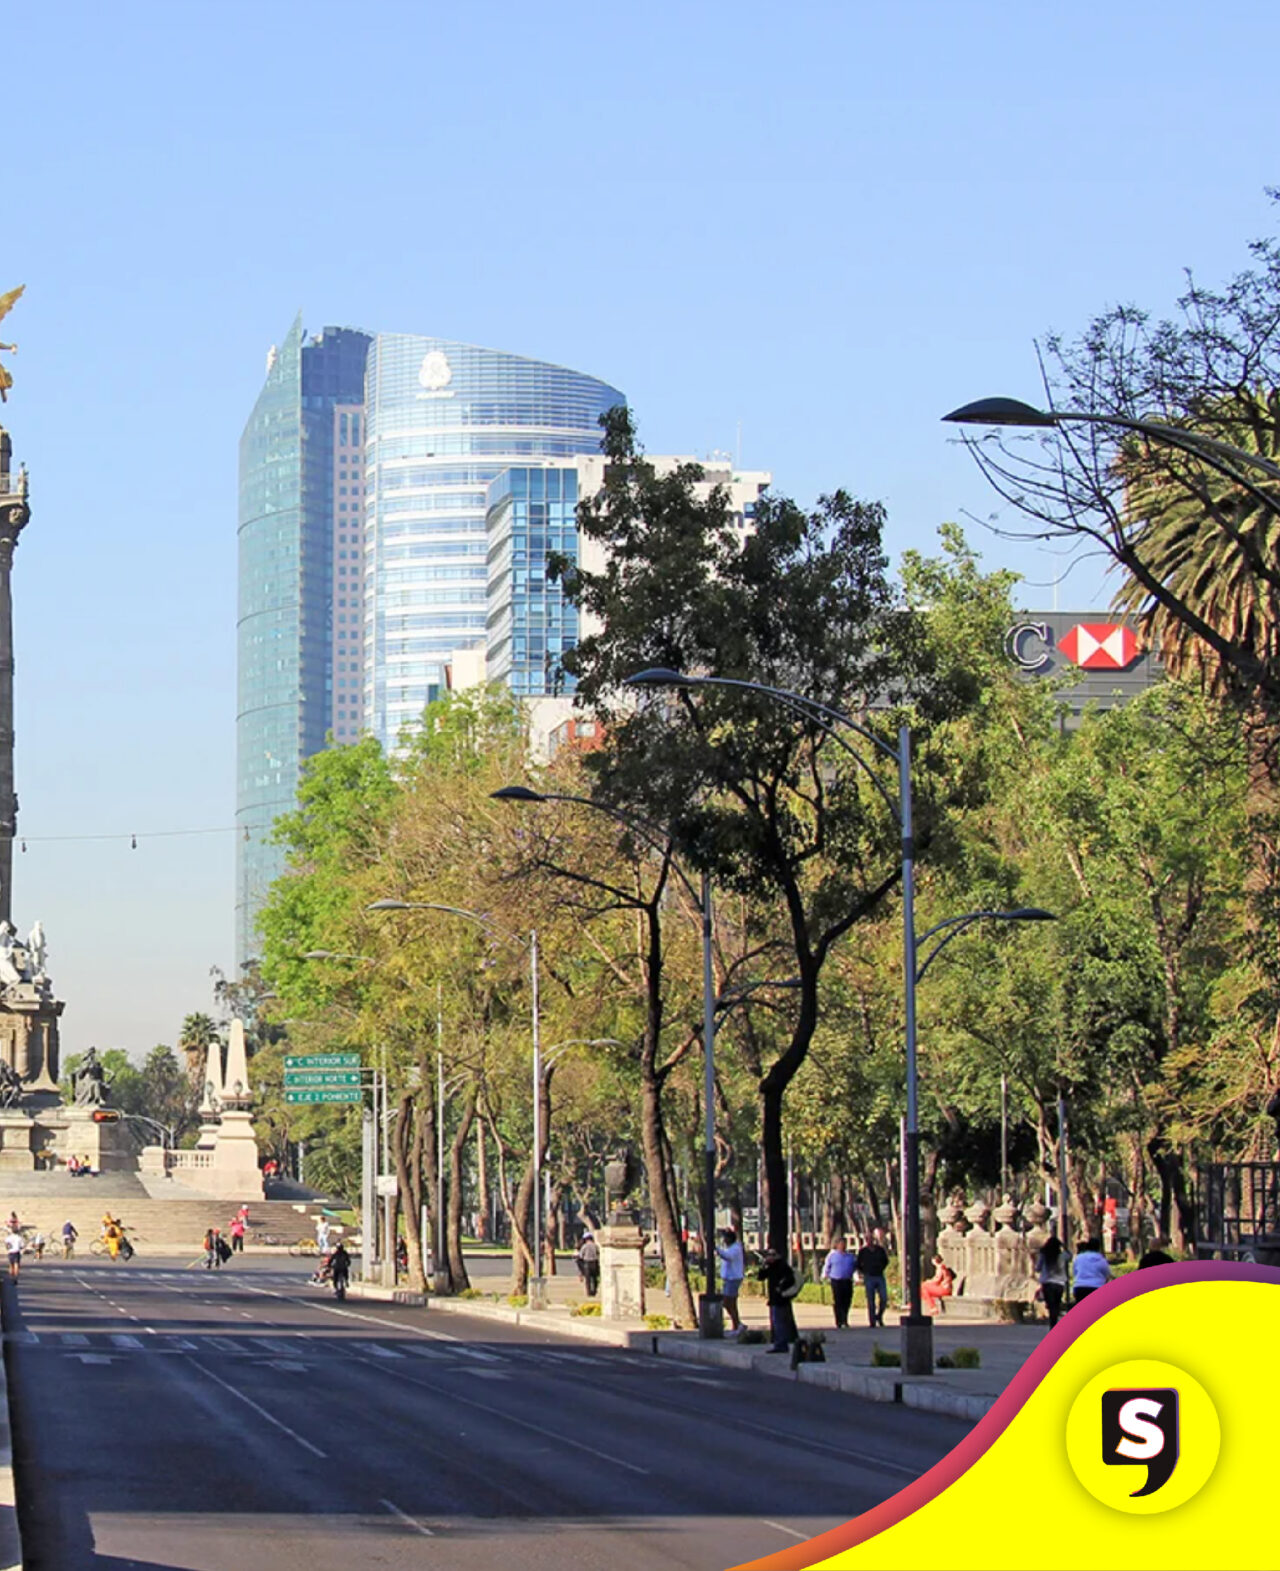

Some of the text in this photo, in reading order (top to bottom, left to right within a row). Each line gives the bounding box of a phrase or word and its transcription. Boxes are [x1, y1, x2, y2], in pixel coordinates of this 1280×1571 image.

[306, 1057, 341, 1065] INTERIOR
[324, 1075, 346, 1083] NORTE
[297, 1093, 312, 1101] EJE
[322, 1092, 359, 1101] PONIENTE
